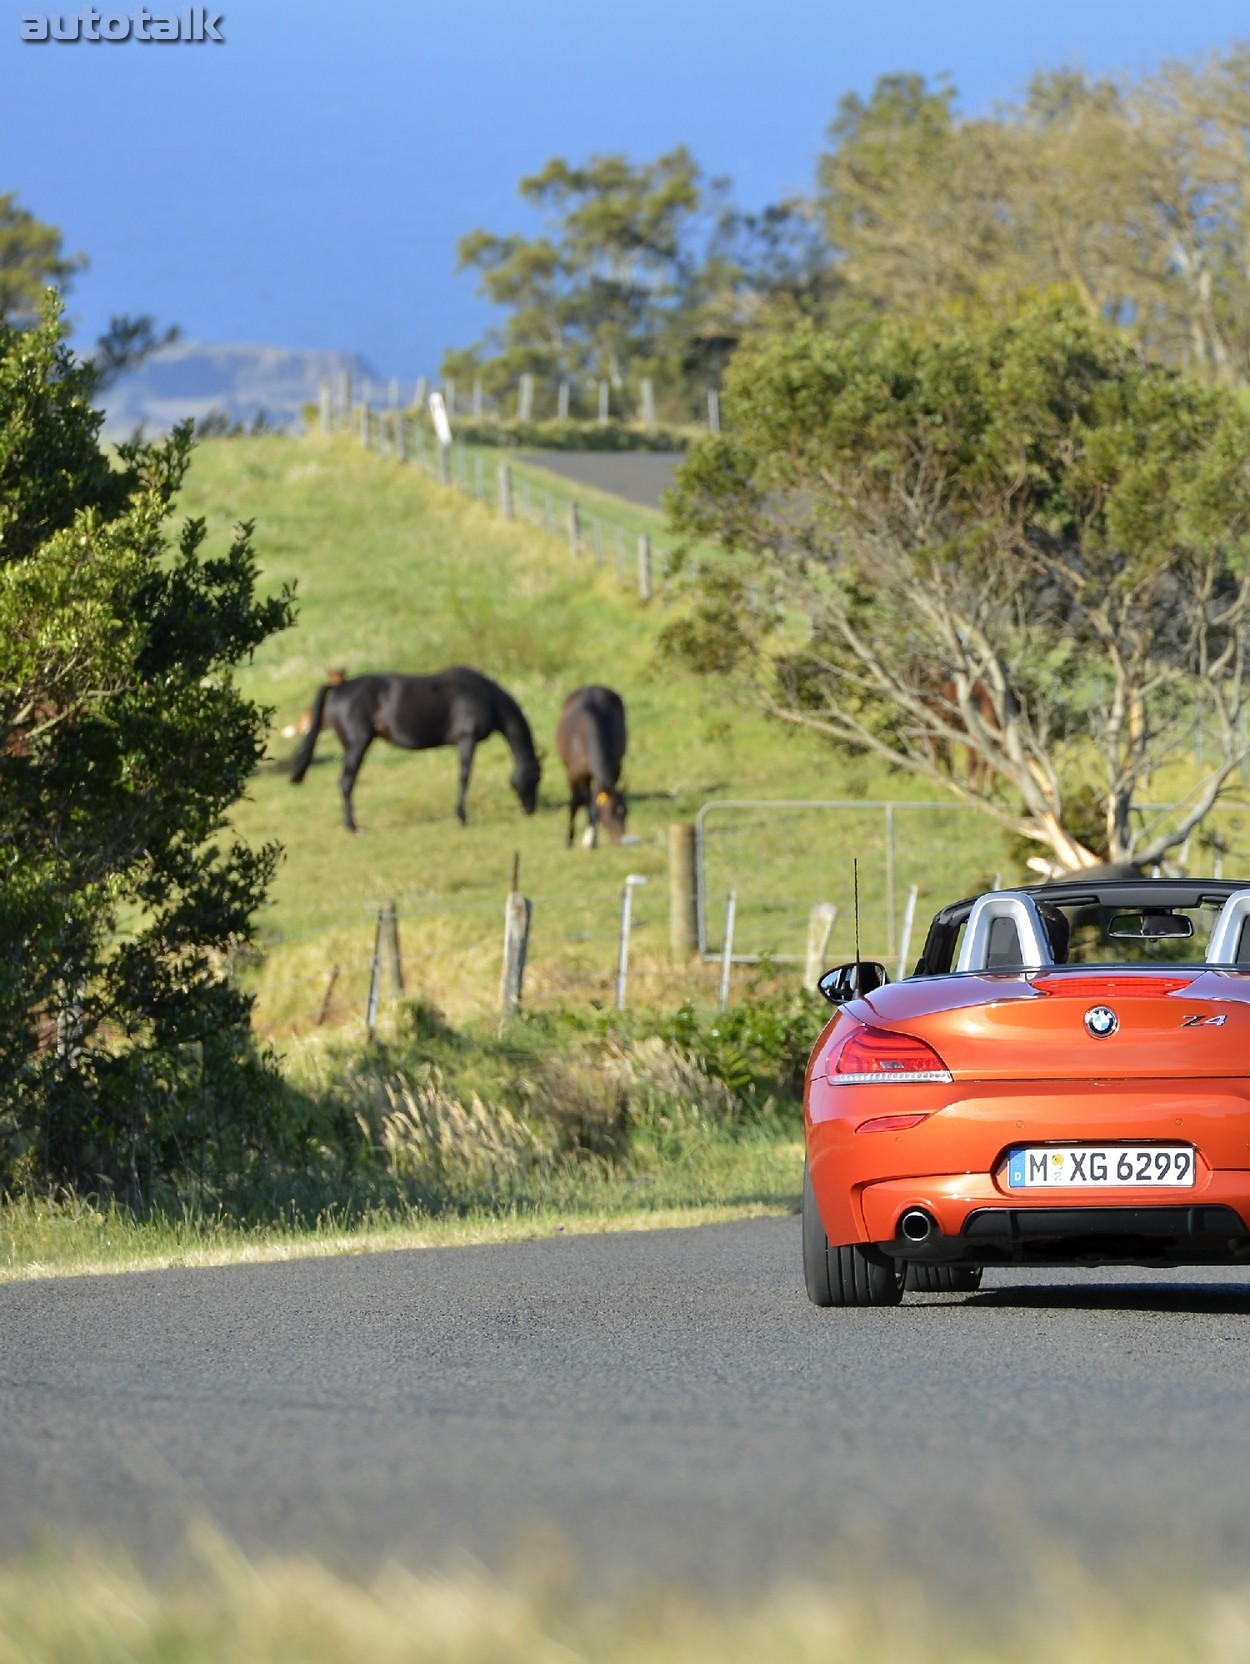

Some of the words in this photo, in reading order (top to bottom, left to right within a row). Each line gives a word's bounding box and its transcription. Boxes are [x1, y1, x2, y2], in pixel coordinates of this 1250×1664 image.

[1180, 1014, 1228, 1028] Z4
[1014, 1172, 1022, 1181] D
[1029, 1153, 1048, 1182] M
[1069, 1152, 1108, 1182] XG
[1116, 1152, 1191, 1182] 6299
